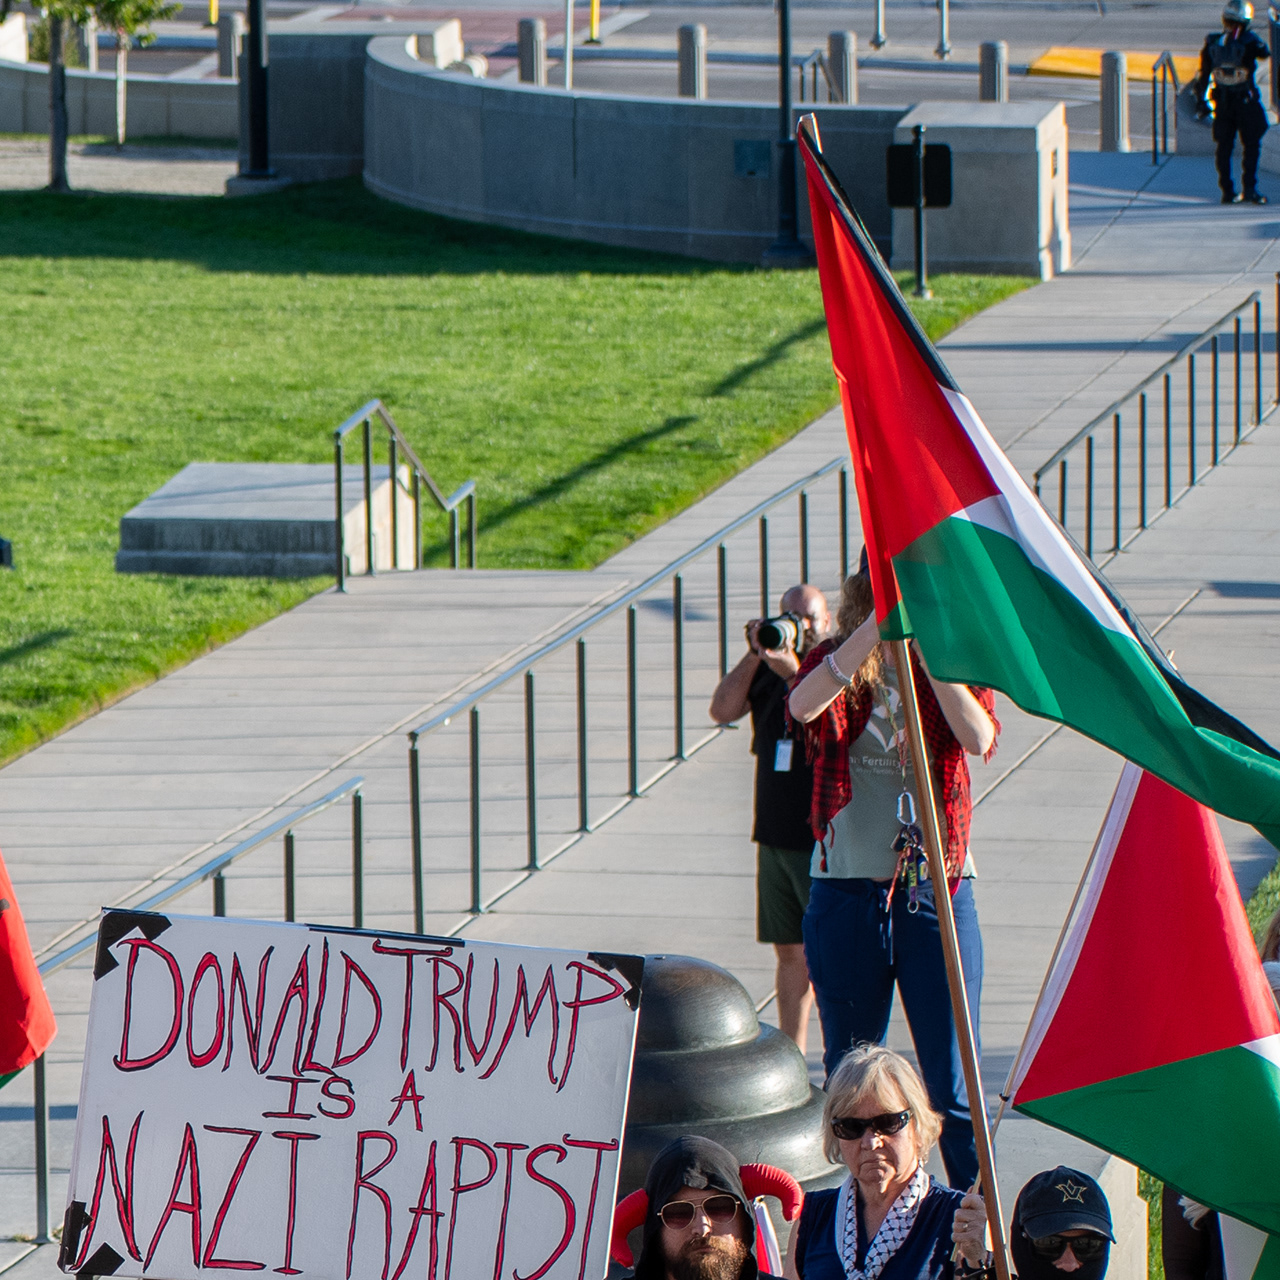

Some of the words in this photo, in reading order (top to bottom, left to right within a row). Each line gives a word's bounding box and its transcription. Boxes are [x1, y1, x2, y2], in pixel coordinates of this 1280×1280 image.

[113, 936, 383, 1077] DONALD
[371, 938, 626, 1093] TRUMP
[262, 1075, 356, 1120] IS
[388, 1069, 425, 1132] A
[70, 1110, 321, 1275] NAZI
